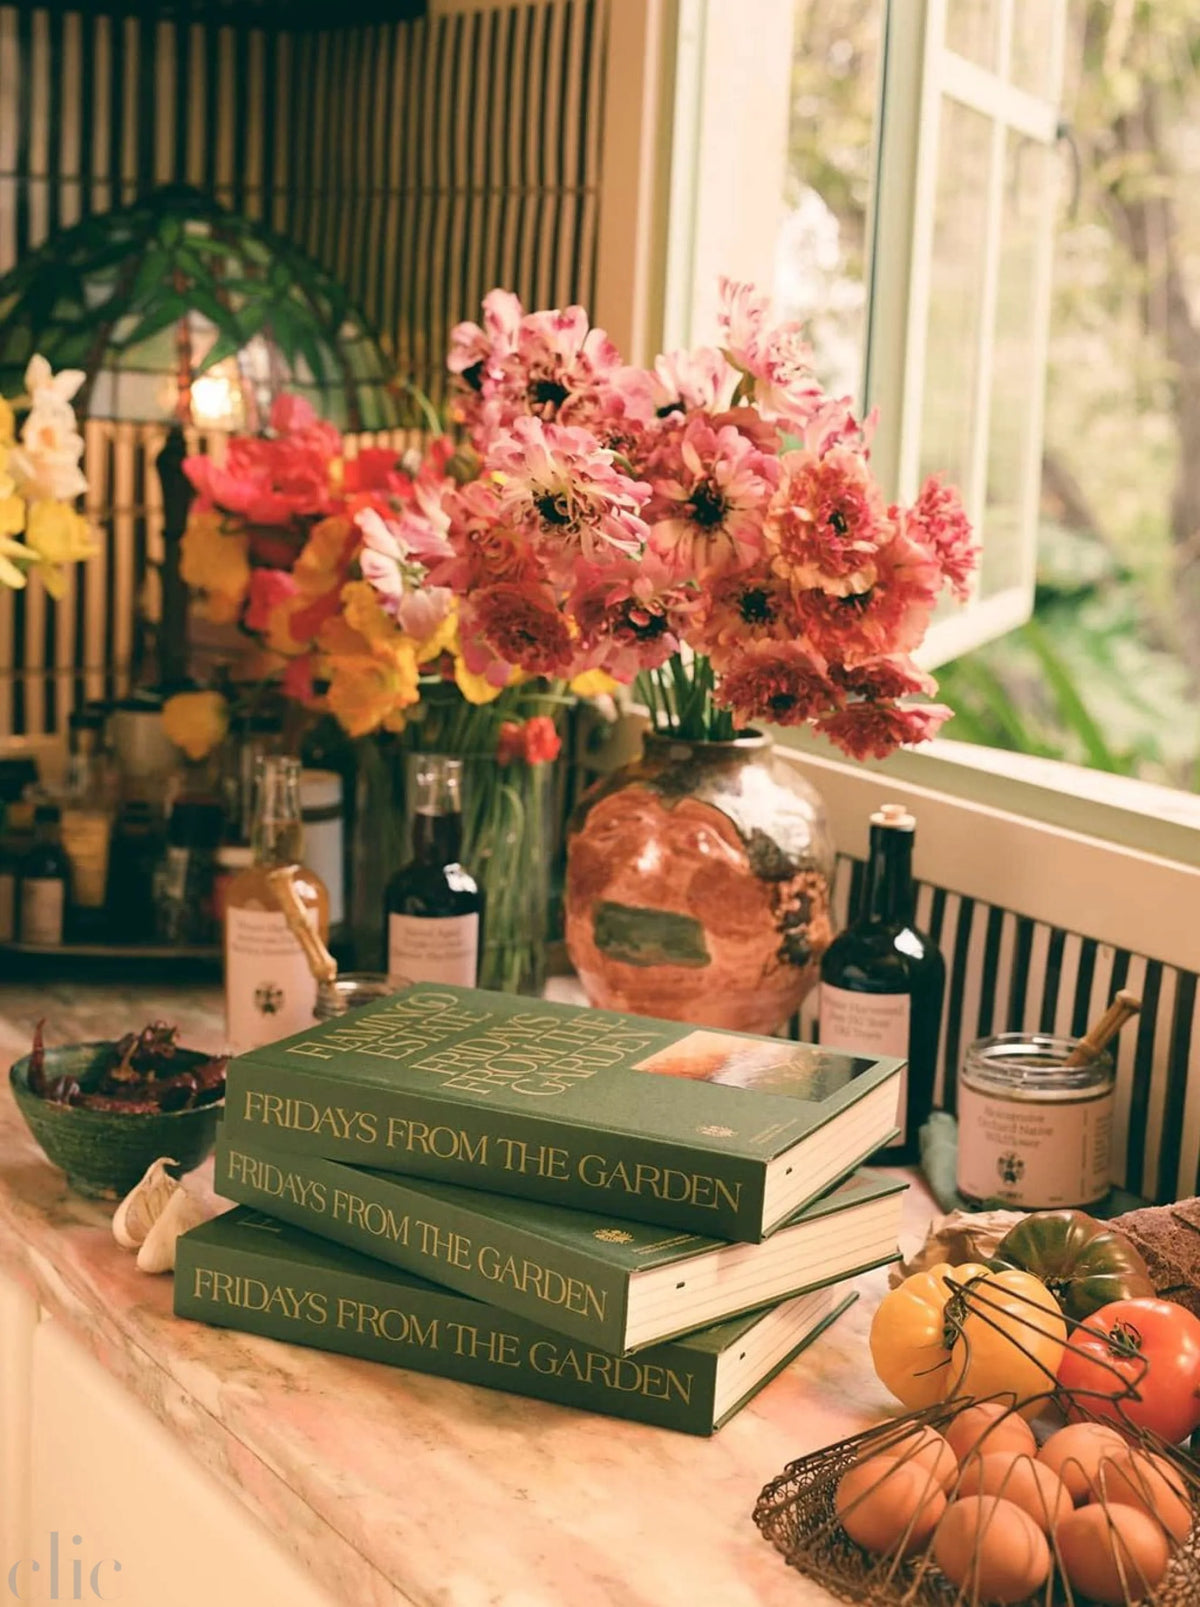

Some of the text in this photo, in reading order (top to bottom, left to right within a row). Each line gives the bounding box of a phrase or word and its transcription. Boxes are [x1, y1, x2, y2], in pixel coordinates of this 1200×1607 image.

[286, 992, 459, 1060] FLAMINGO
[355, 1009, 493, 1060] ESTATE
[409, 1013, 561, 1075] FRIDAYS
[442, 1013, 627, 1094] FROM THE
[511, 1025, 665, 1096] GARDEN
[243, 1091, 743, 1214] FRIDAYS FROM THE GARDEN
[227, 1150, 608, 1323] FRIDAYS FROM THE GARDEN
[193, 1267, 694, 1406] FRIDAYS FROM THE GARDEN
